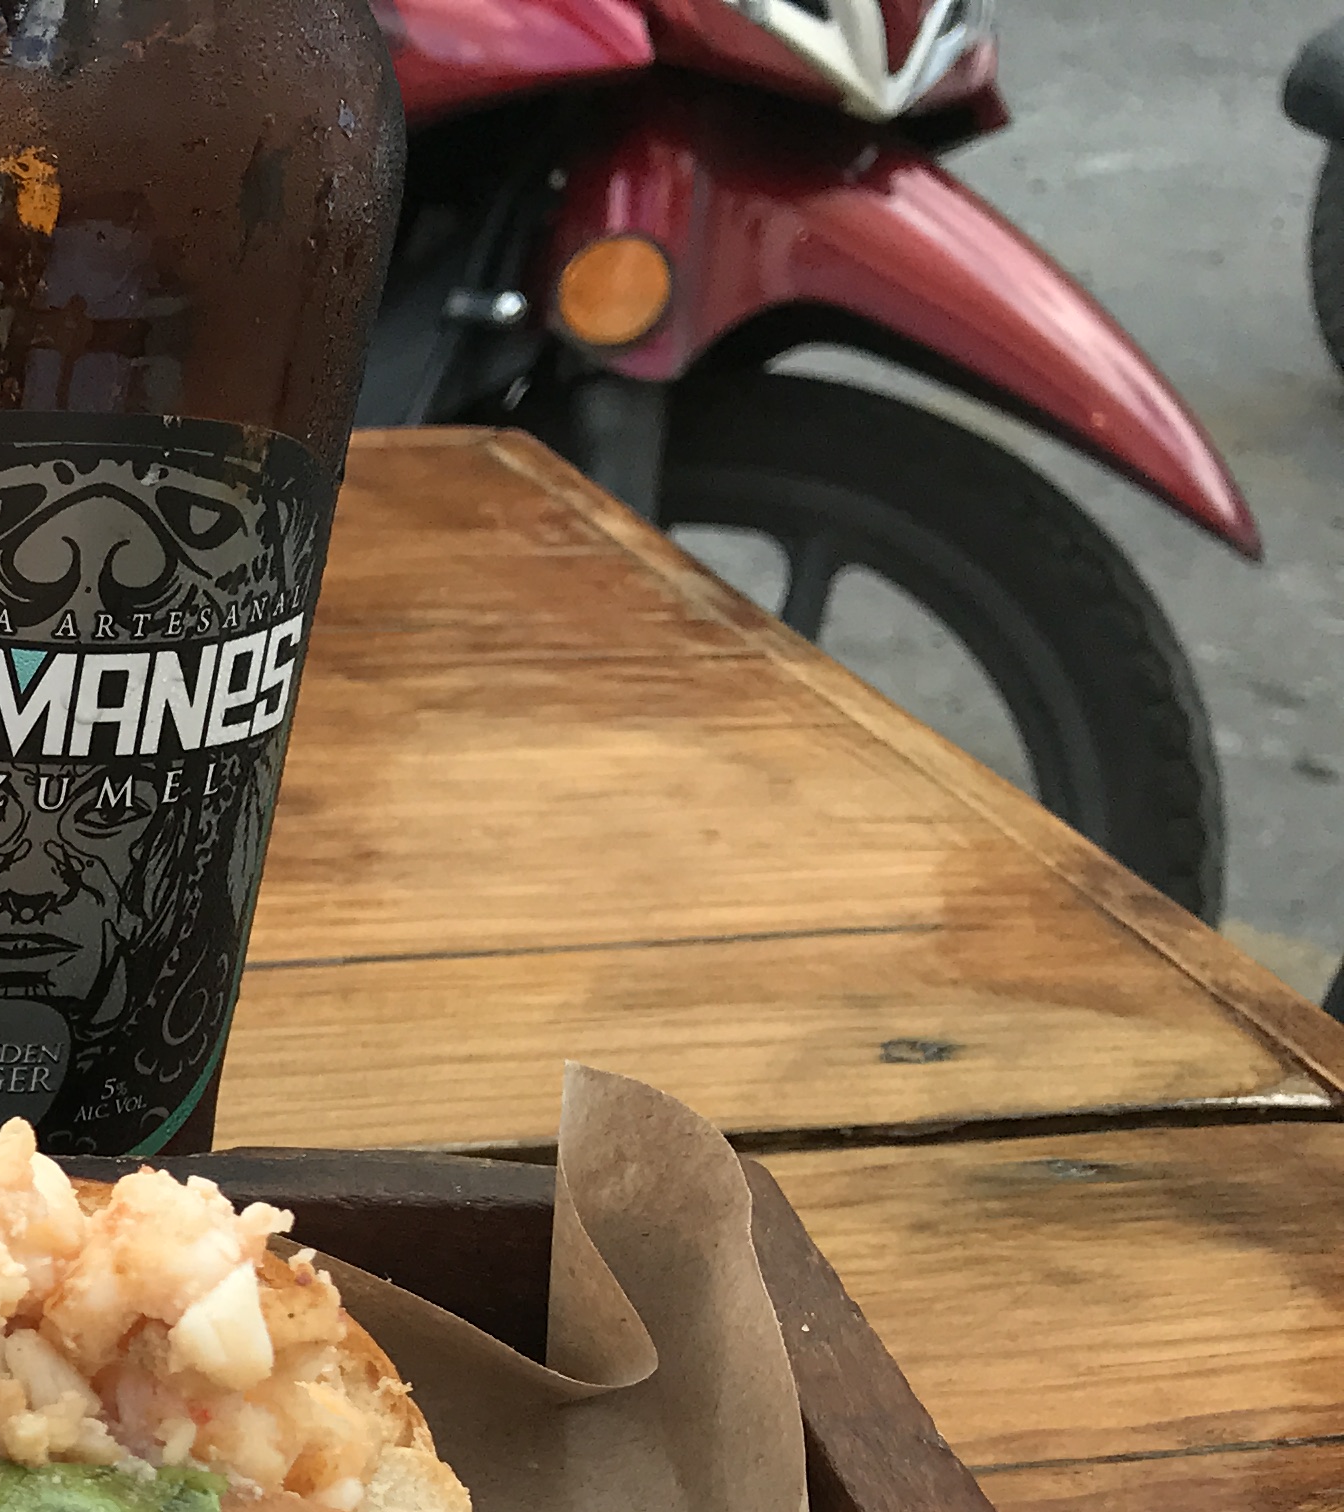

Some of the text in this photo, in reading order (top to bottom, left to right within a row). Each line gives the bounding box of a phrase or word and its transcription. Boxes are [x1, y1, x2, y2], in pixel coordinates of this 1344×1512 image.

[55, 584, 304, 638] ARTESANAL
[100, 1077, 128, 1100] 5%
[115, 1094, 148, 1114] VOL
